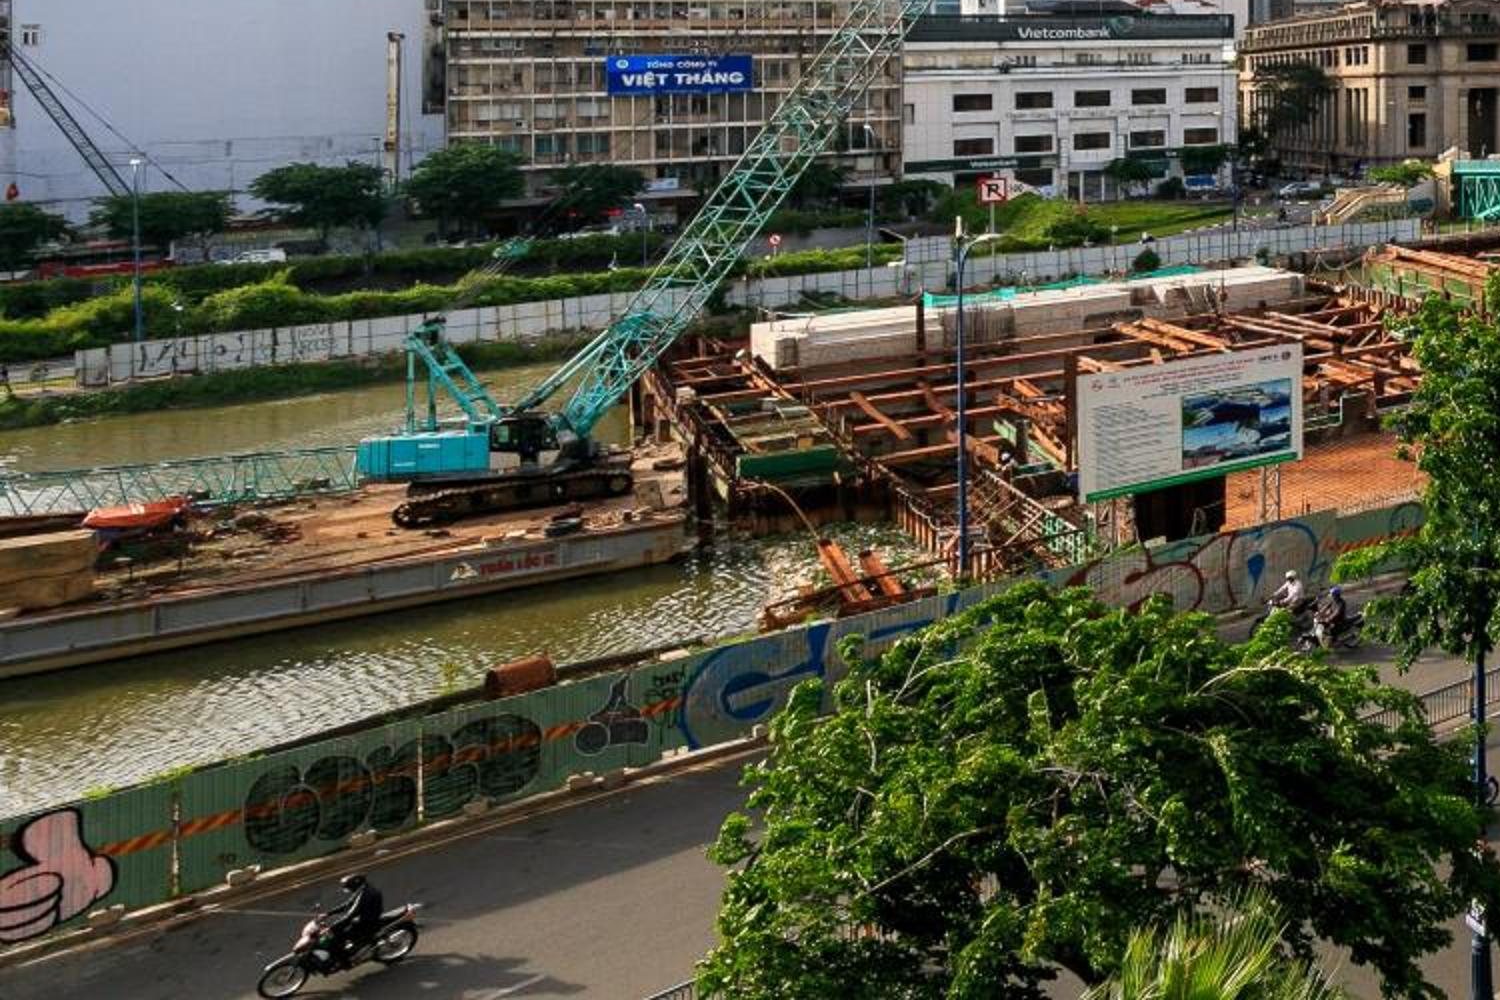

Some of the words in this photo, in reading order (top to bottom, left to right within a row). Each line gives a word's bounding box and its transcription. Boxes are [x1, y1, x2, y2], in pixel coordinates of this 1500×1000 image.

[1017, 26, 1111, 39] Vietcombank
[621, 71, 669, 88] VIỆT
[673, 68, 745, 85] THẮNG
